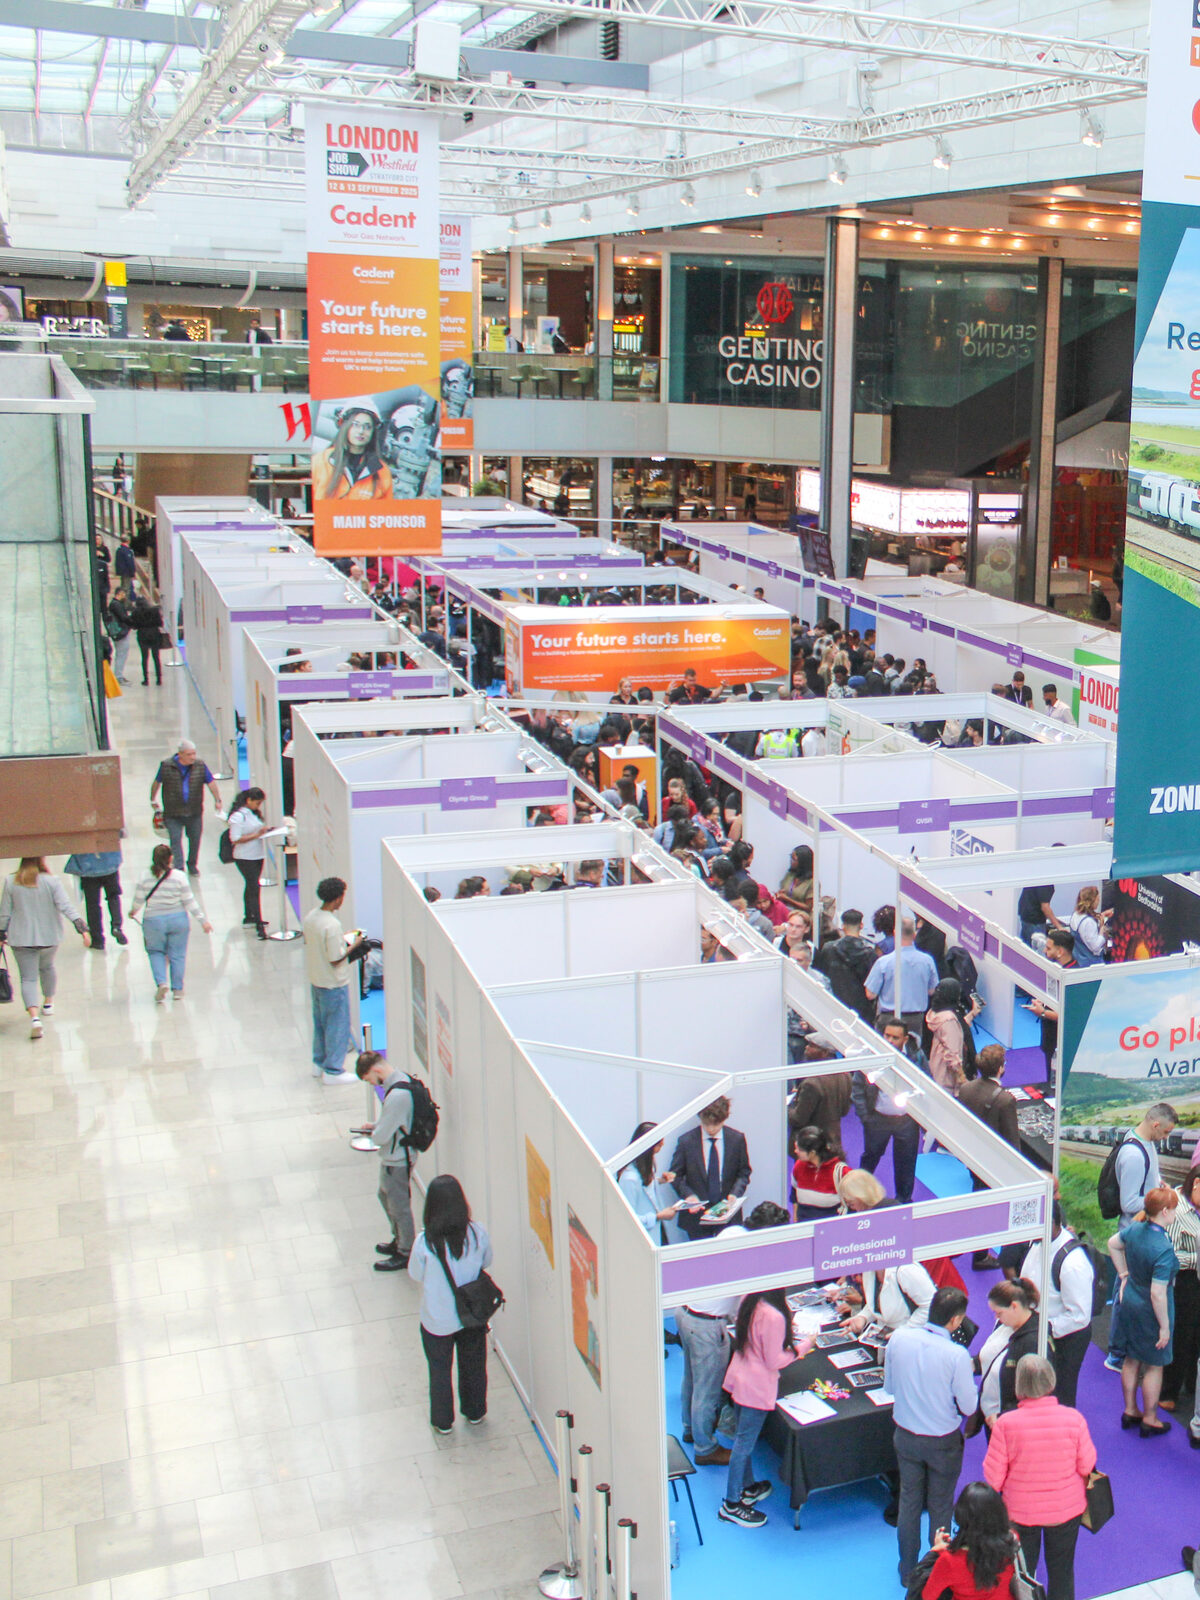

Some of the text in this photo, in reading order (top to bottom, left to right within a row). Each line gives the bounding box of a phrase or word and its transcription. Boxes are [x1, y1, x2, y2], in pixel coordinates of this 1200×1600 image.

[326, 123, 418, 153] LONDON
[328, 151, 348, 163] JOB
[371, 153, 417, 172] Westfield
[328, 164, 359, 176] SHOW
[329, 182, 337, 190] 12
[330, 205, 416, 228] Cadent
[353, 266, 395, 279] Cadent
[320, 300, 427, 319] Your future
[321, 320, 427, 337] starts here.
[726, 362, 821, 389] CASINO
[333, 515, 426, 529] MAIN SPONSOR
[531, 629, 726, 648] Your future starts here.
[753, 627, 782, 636] Cadent
[1138, 883, 1159, 902] University
[1119, 1026, 1160, 1051] Go
[857, 1219, 871, 1230] 29
[831, 1236, 896, 1256] Professional
[821, 1248, 907, 1271] Careers Training
